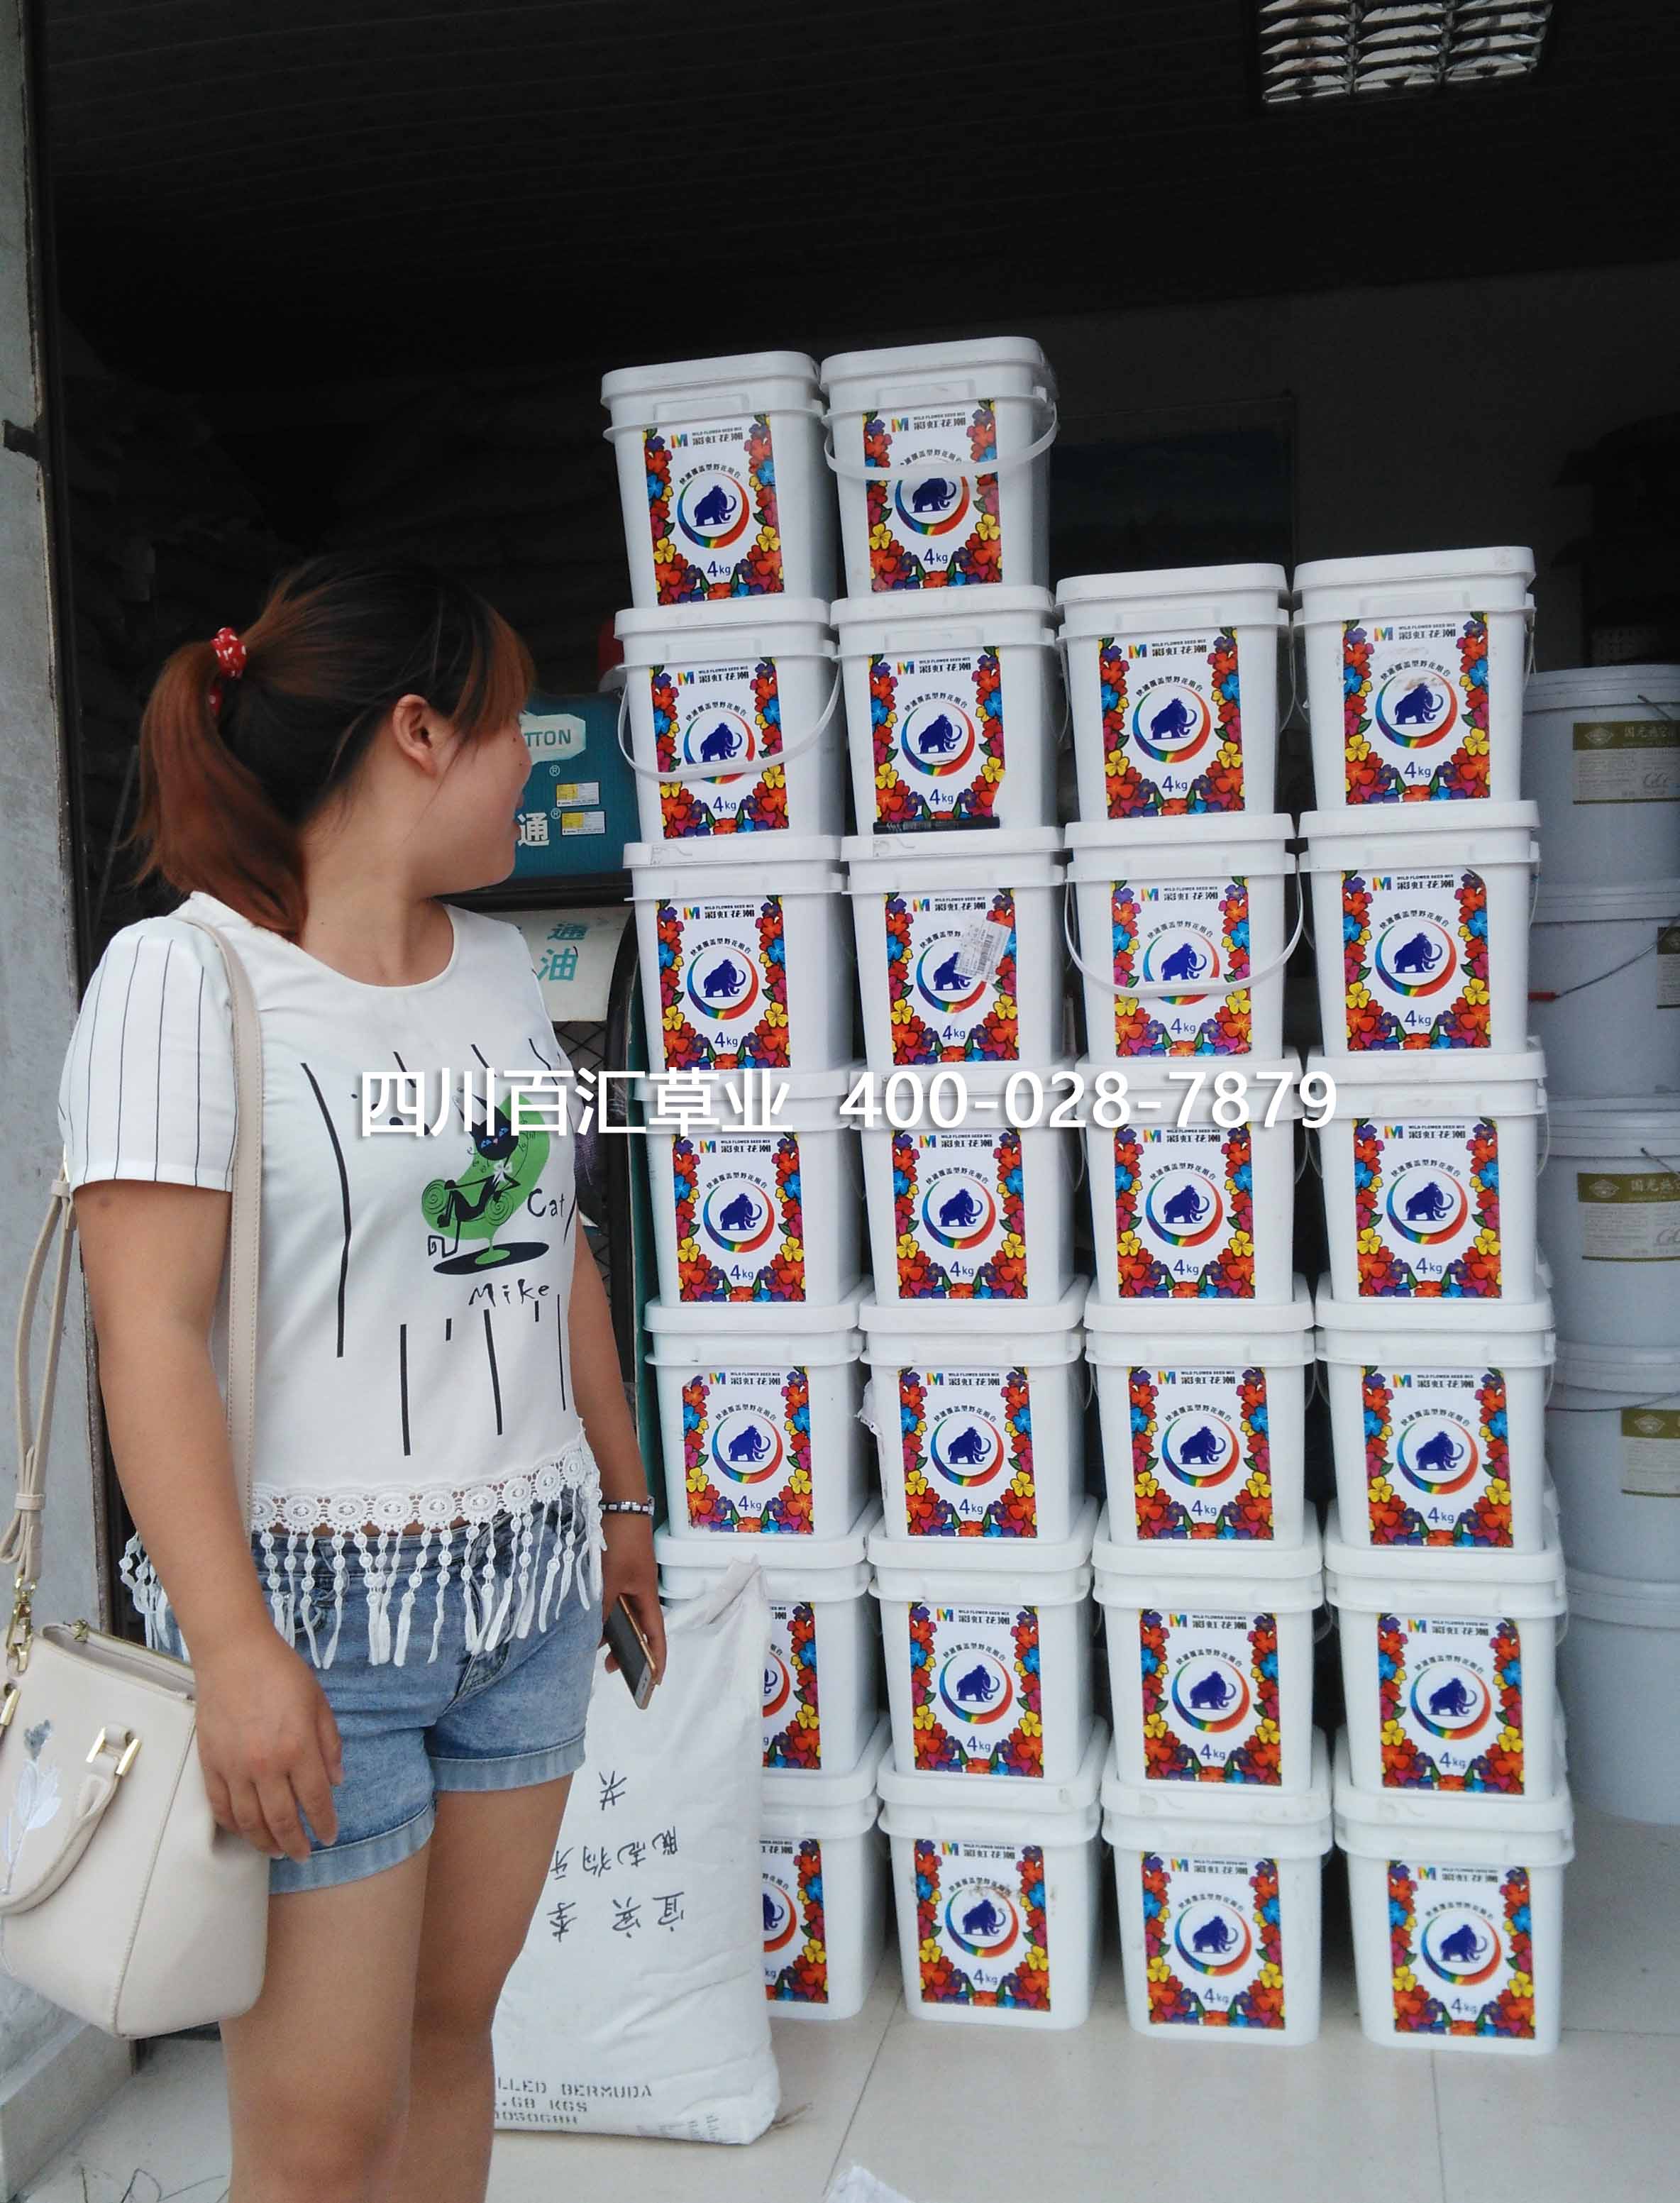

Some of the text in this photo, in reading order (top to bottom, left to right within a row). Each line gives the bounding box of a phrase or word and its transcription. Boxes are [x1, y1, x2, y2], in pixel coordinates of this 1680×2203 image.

[527, 1188, 565, 1218] Cat
[468, 1279, 550, 1308] Mike
[561, 2083, 652, 2099] BERMUDA
